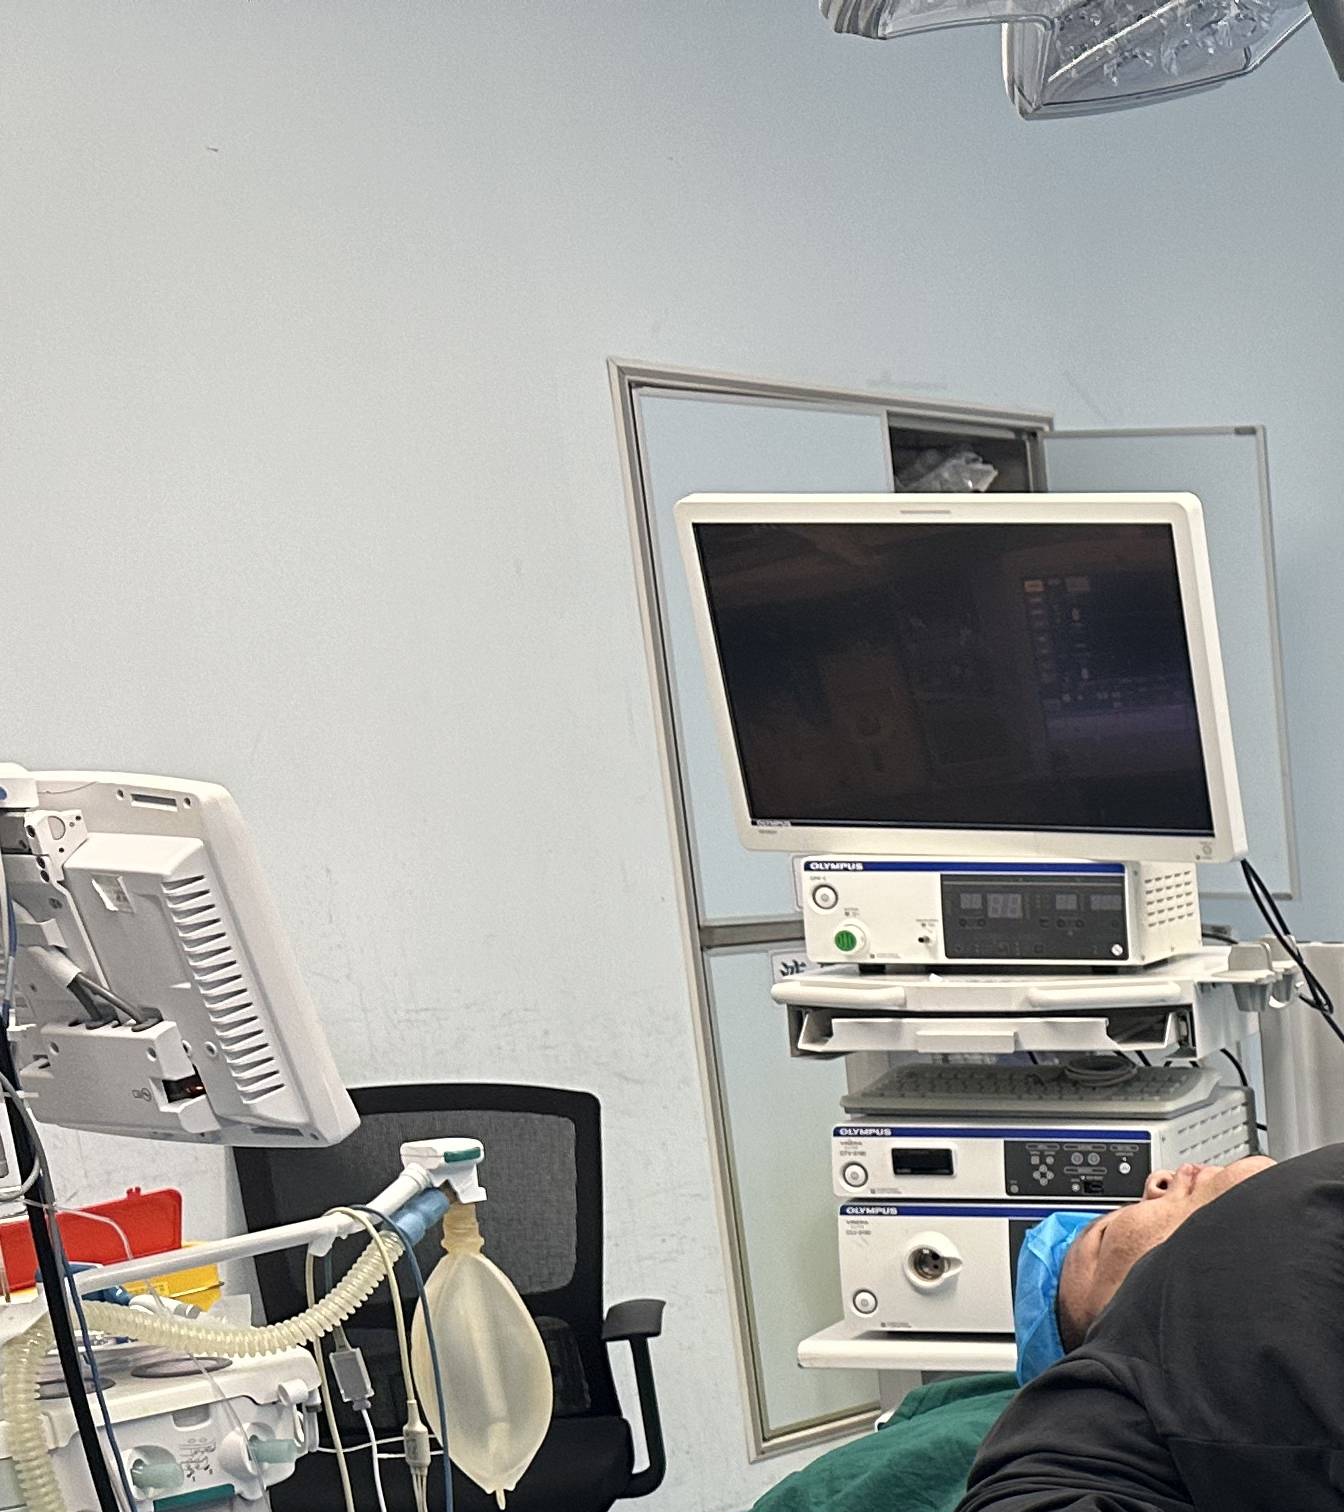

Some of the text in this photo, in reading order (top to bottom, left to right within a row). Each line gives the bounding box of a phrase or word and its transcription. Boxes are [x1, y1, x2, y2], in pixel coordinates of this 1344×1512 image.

[809, 862, 864, 871] OLYMPUS
[839, 1128, 892, 1136] OLYMPUS
[845, 1206, 898, 1215] OLYMPUS
